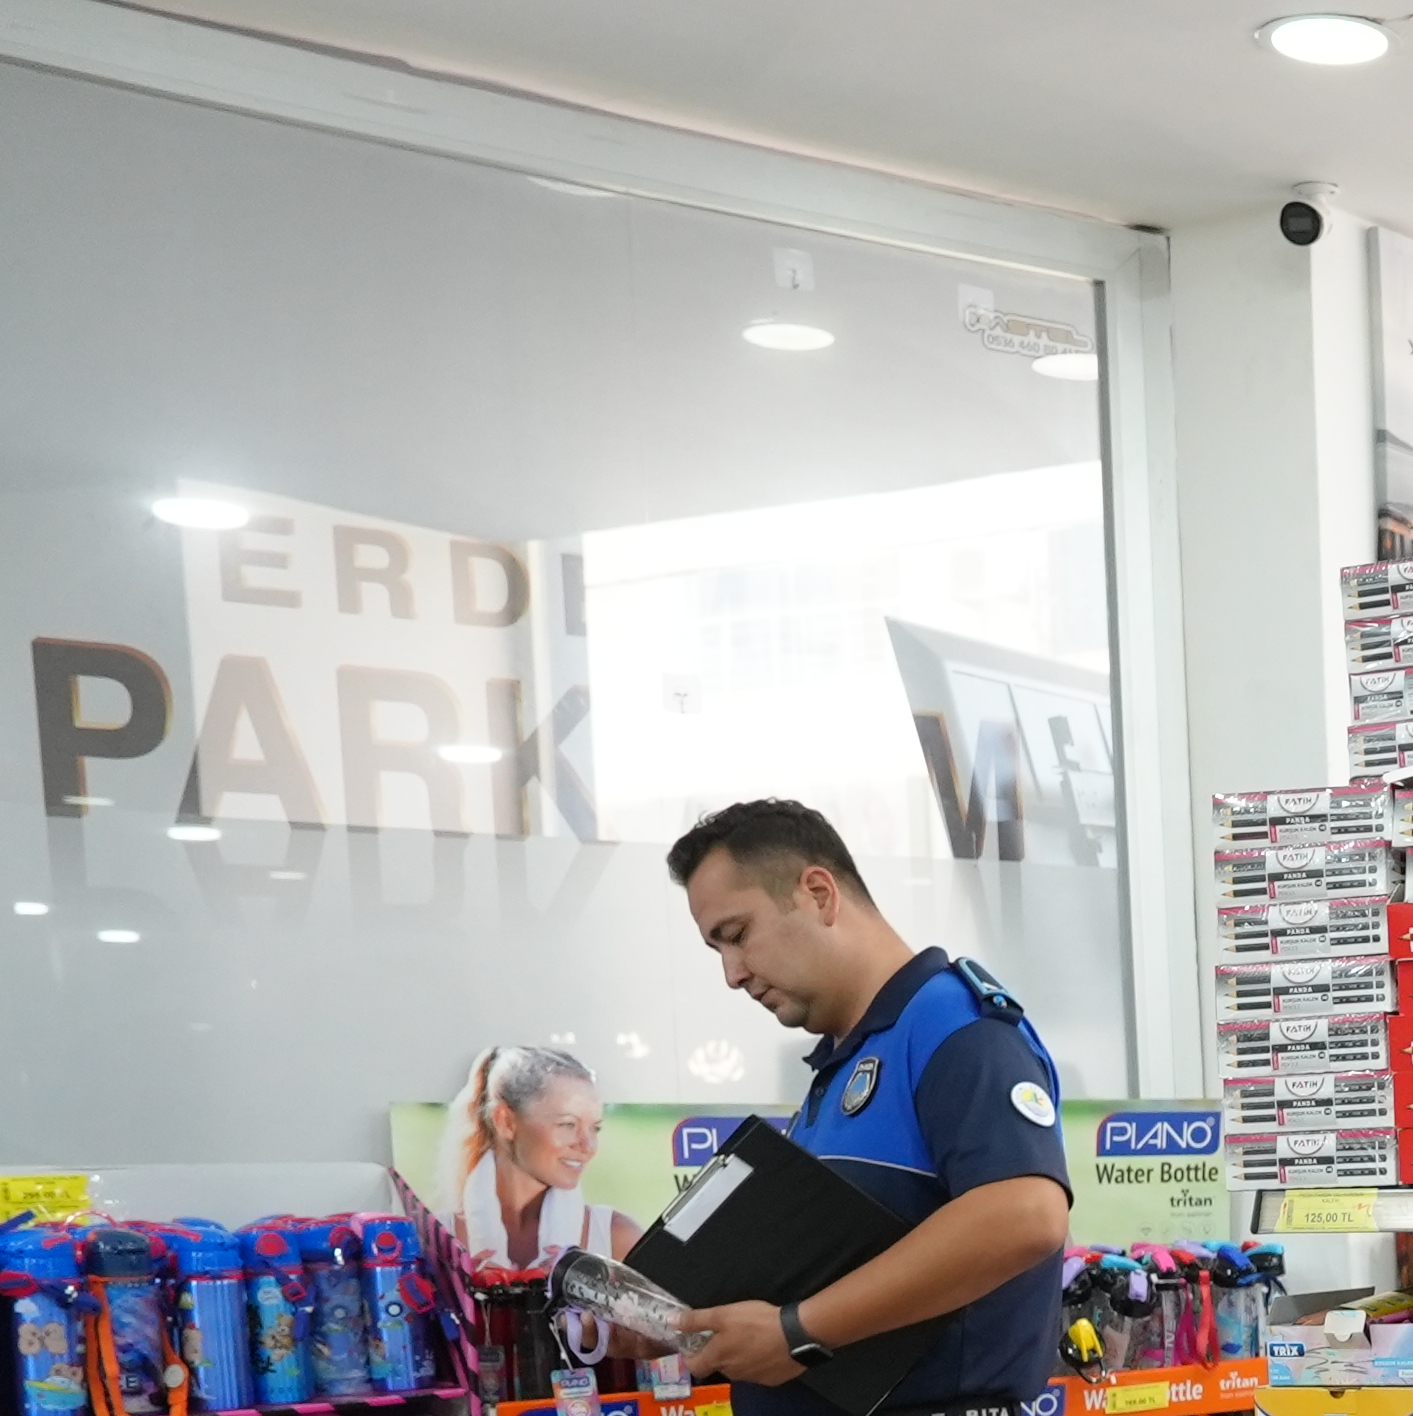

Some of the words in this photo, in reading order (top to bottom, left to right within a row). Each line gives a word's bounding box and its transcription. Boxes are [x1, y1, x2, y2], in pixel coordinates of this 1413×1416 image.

[31, 637, 621, 844] PARK
[1287, 1043, 1311, 1051] PANDA
[1103, 1118, 1213, 1152] PIANO
[1095, 1161, 1156, 1185] Water
[1160, 1159, 1219, 1184] Bottle
[1169, 1190, 1213, 1208] tritan
[1304, 1210, 1337, 1224] 125,00
[1339, 1211, 1354, 1224] TL
[1219, 1376, 1259, 1391] tritan
